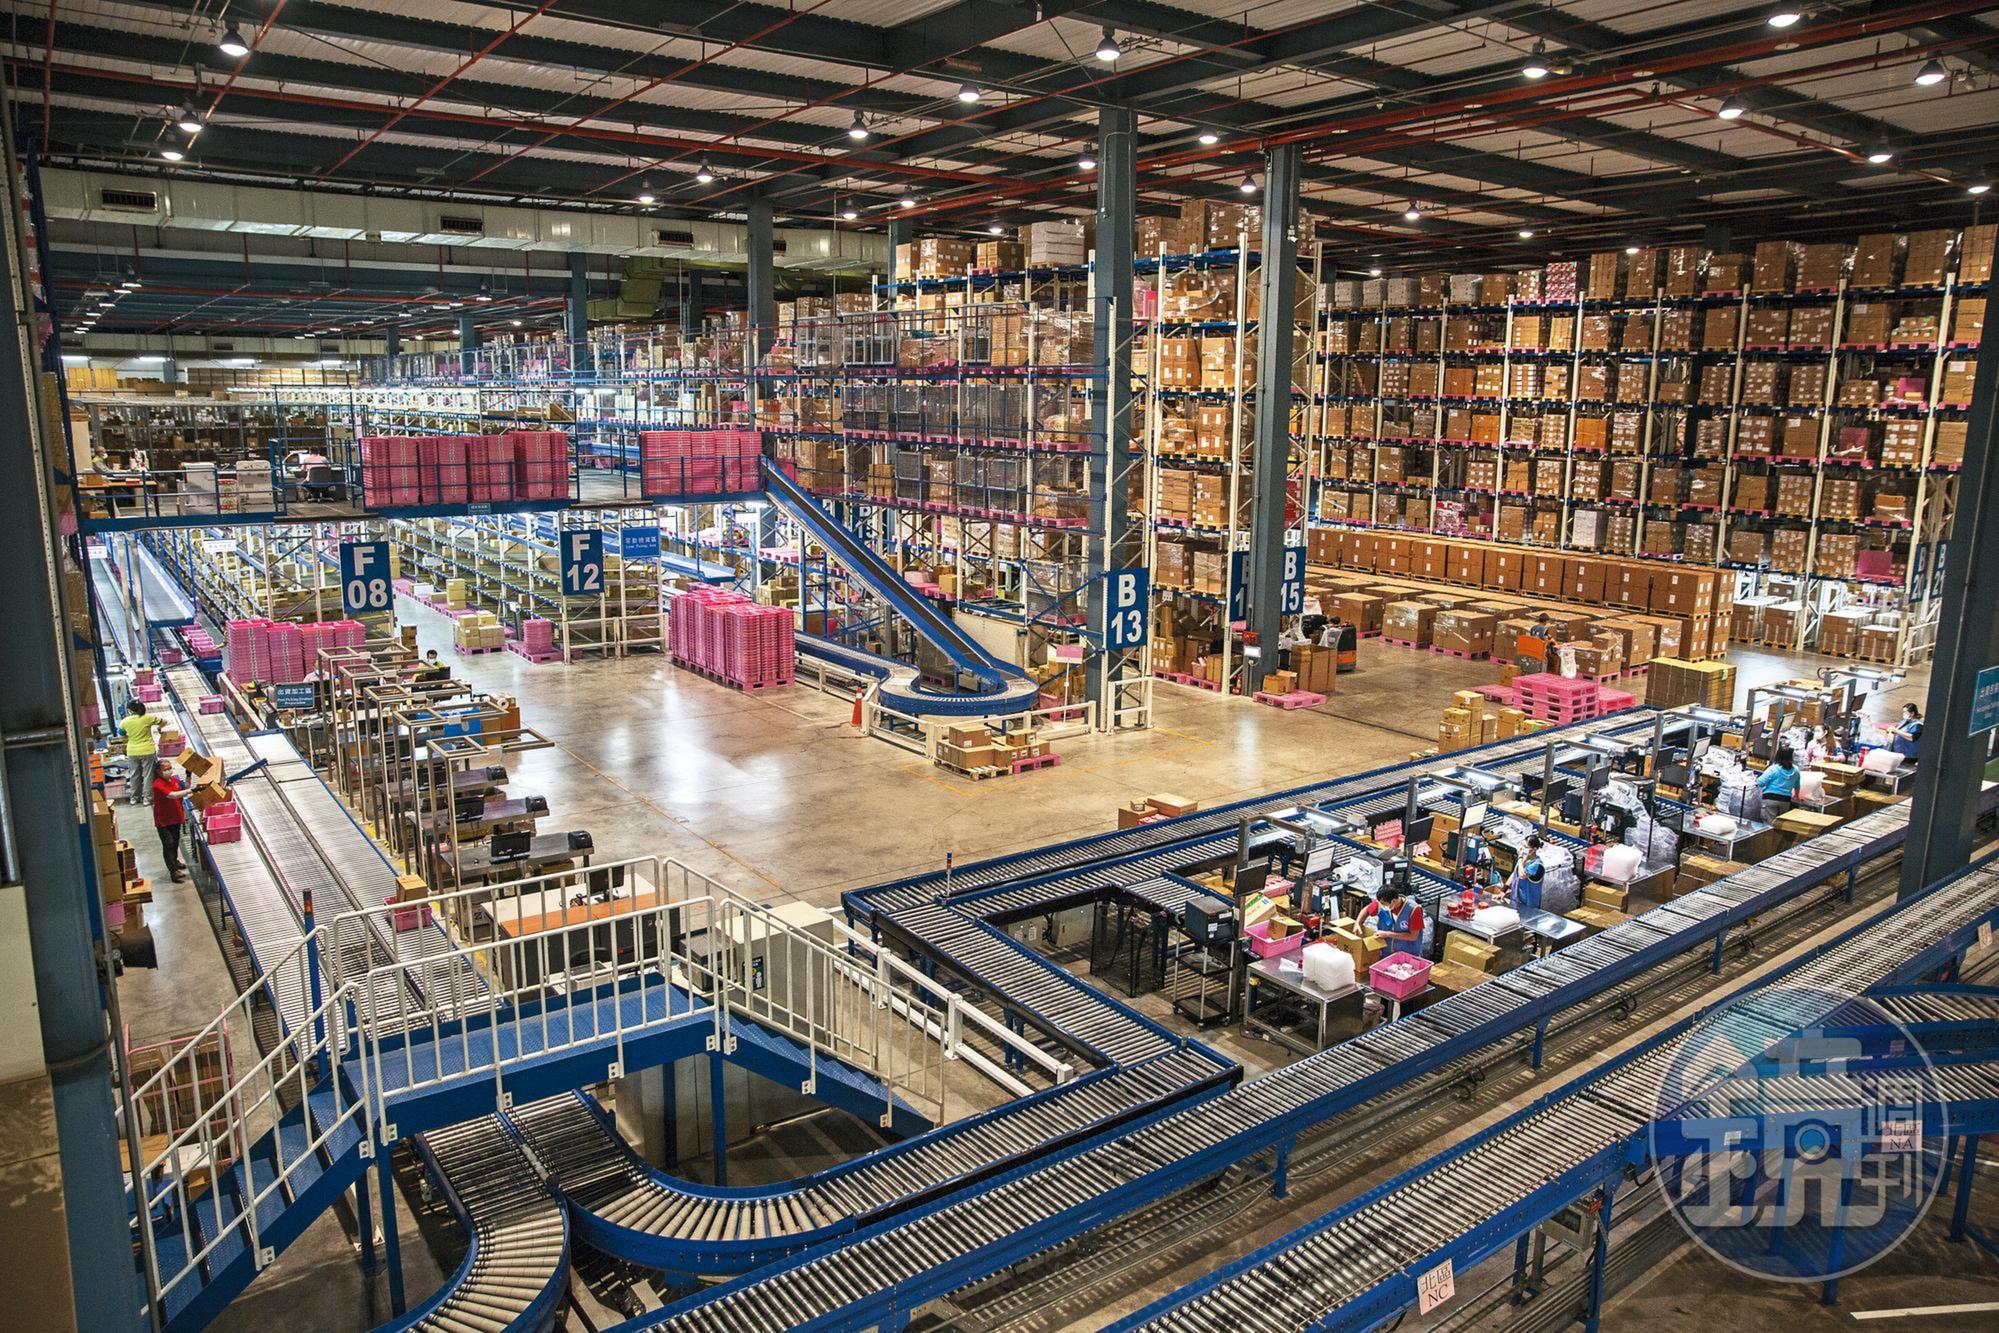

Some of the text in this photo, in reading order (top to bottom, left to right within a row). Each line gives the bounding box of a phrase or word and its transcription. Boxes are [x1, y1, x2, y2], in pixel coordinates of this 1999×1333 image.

[353, 546, 375, 576] F
[572, 533, 591, 561] F
[1938, 543, 1947, 570] B
[567, 563, 600, 591] 12
[1285, 551, 1297, 580] B
[347, 578, 388, 609] 08
[1118, 573, 1136, 608] B
[1280, 582, 1300, 612] 15
[1111, 609, 1142, 645] 13
[1890, 1137, 1914, 1150] NA
[1421, 1262, 1452, 1295] 北區
[1428, 1283, 1449, 1307] NC
